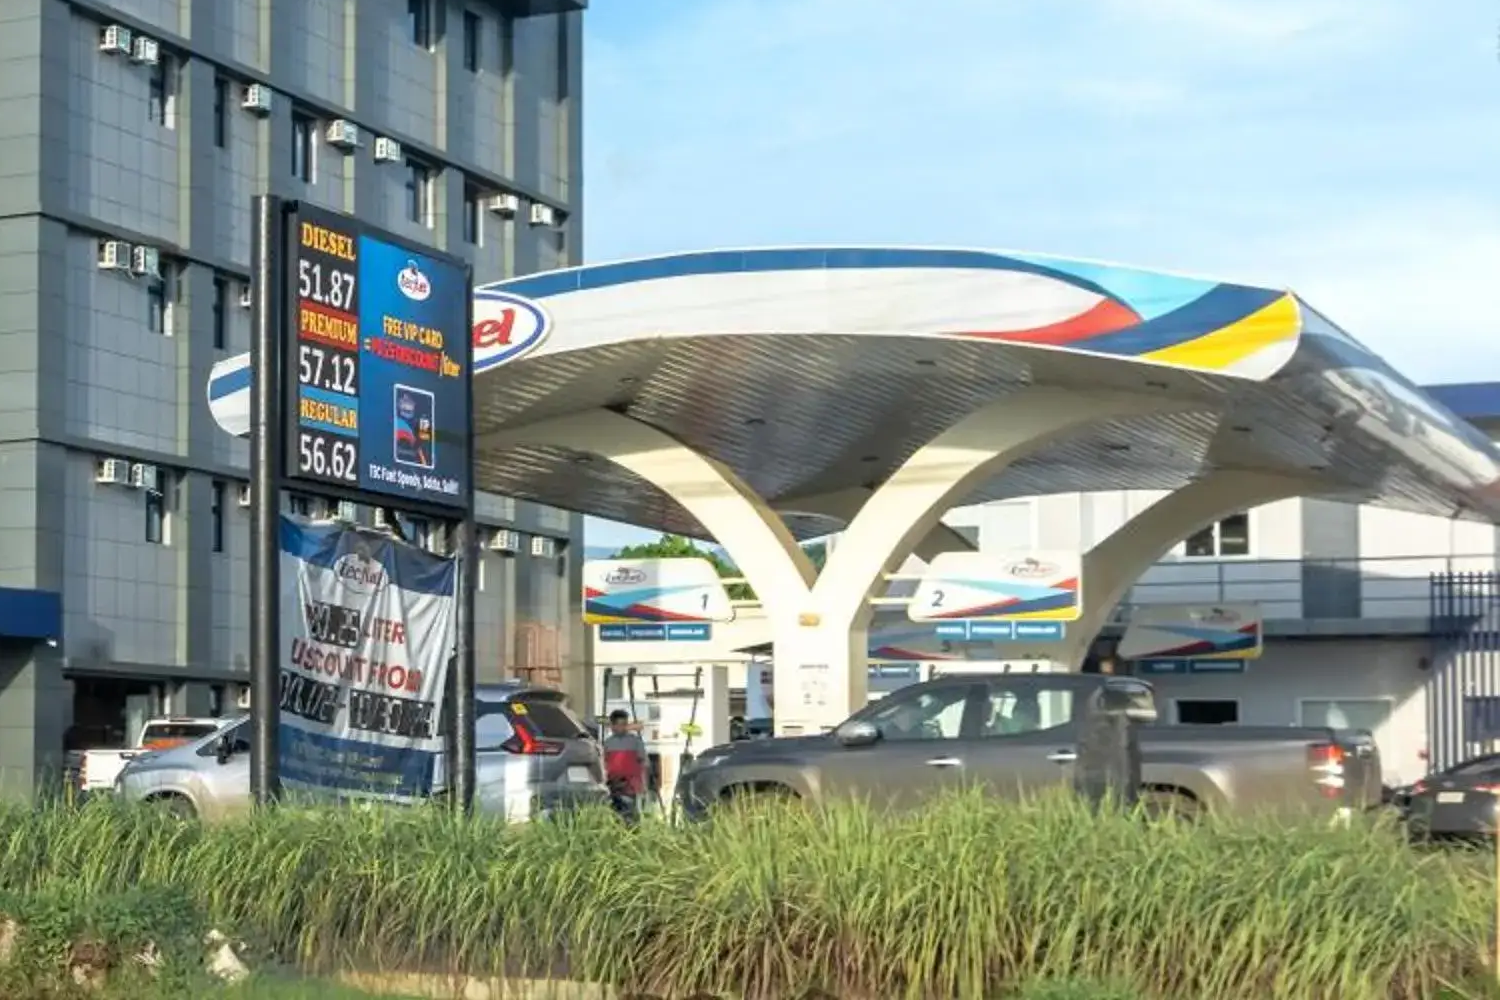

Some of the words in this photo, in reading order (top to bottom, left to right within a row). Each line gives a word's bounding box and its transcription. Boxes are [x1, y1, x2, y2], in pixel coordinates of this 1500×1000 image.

[301, 222, 356, 262] DIESEL
[299, 258, 355, 311] 51.87
[301, 309, 357, 345] PREMIUM
[383, 314, 402, 339] FREE
[419, 327, 443, 349] CARD
[299, 345, 356, 395] 57.12
[300, 398, 357, 429] REGULAR
[300, 433, 357, 481] 56.62
[701, 593, 709, 610] 1
[931, 590, 945, 607] 2
